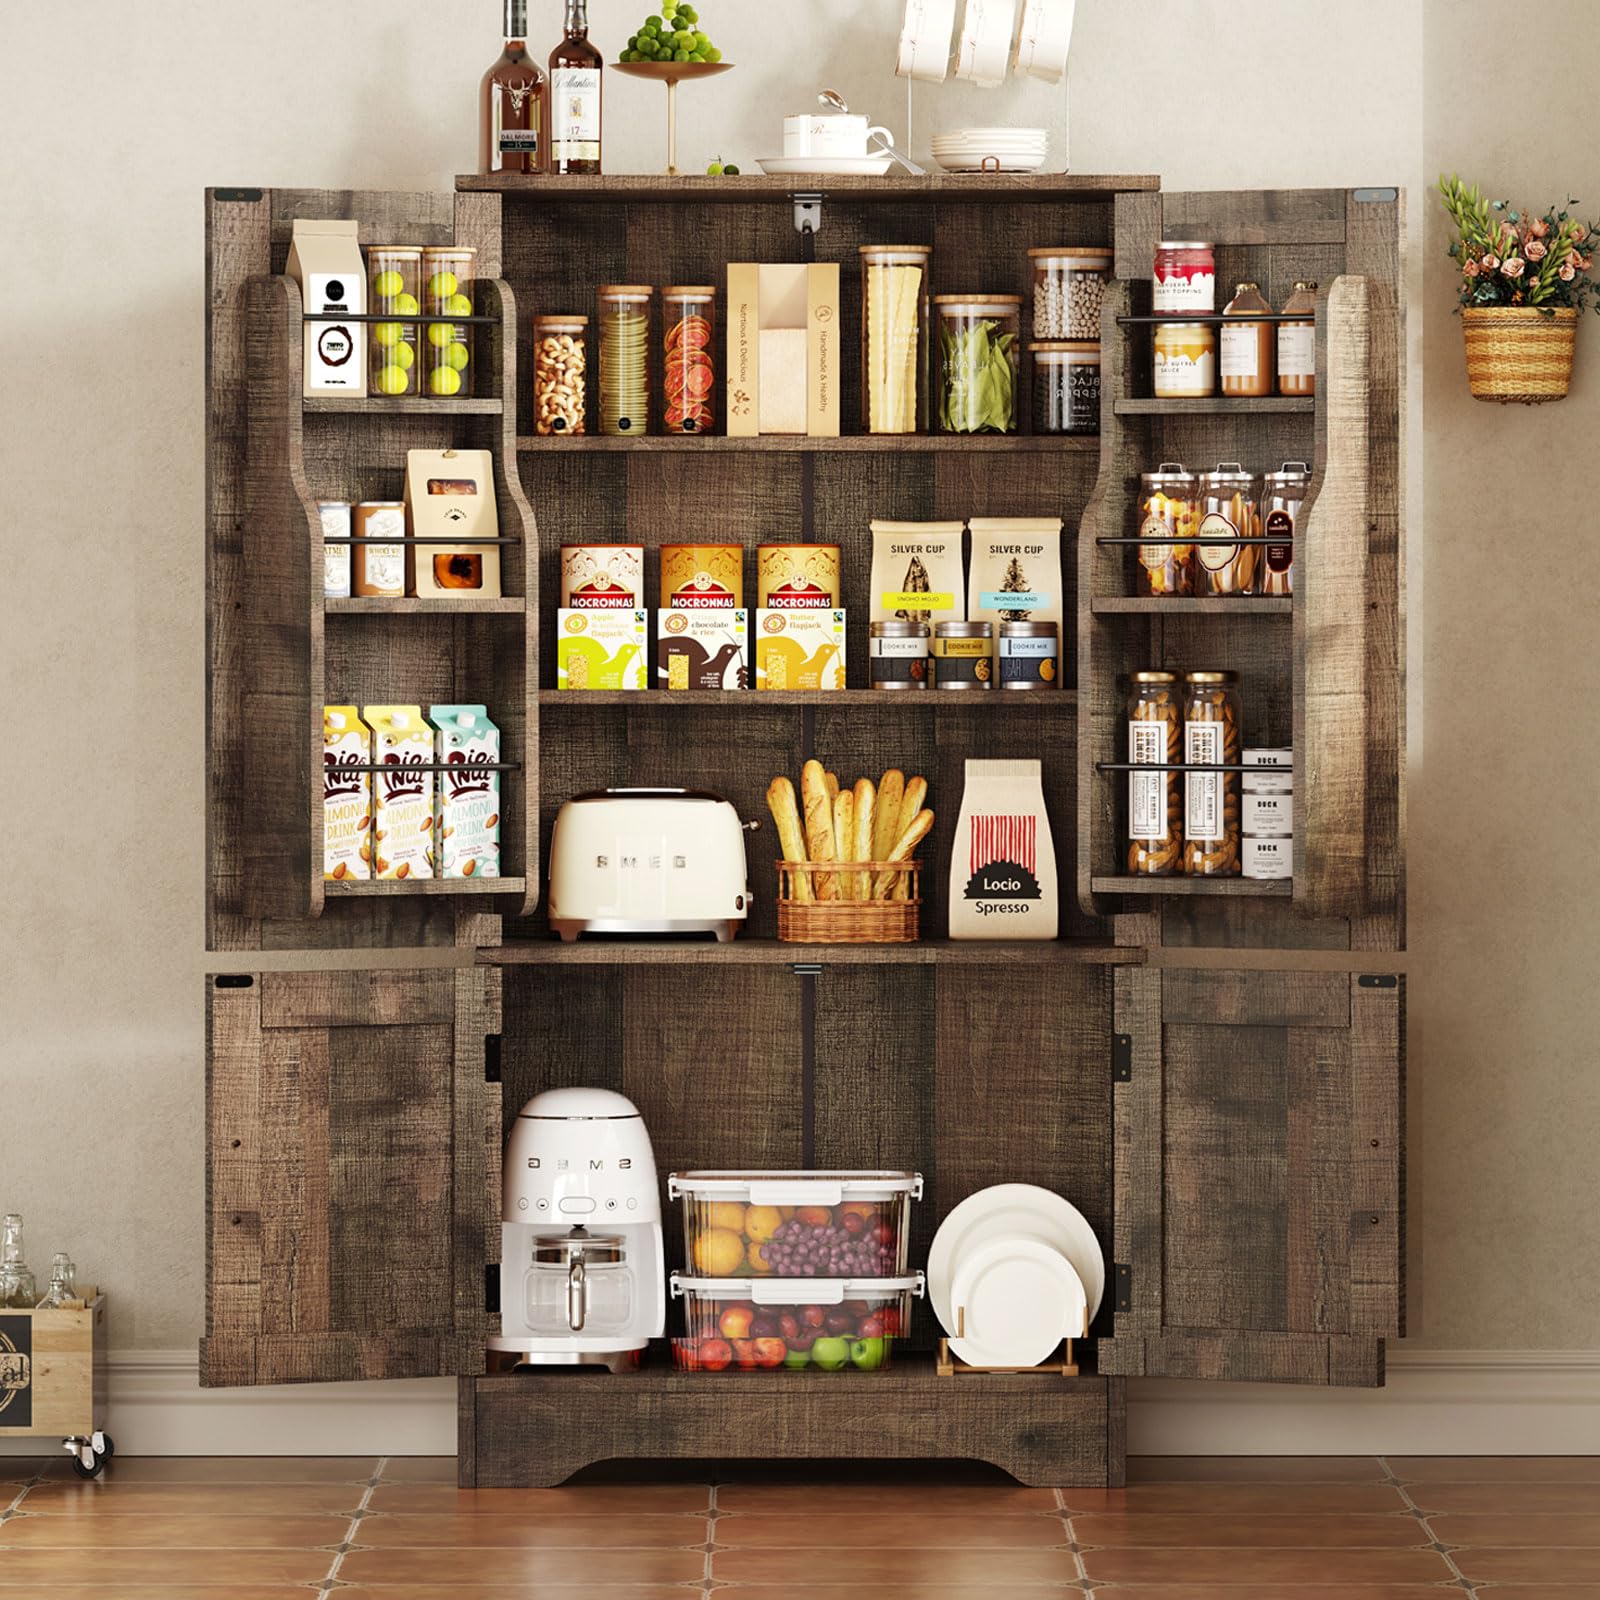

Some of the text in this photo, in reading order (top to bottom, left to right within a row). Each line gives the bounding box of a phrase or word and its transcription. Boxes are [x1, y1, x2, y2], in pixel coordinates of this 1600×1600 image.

[740, 303, 748, 338] Nutritious
[819, 330, 828, 373] Handmade
[740, 348, 748, 383] Delicious
[819, 383, 828, 412] Healthy
[890, 545, 945, 553] SILVER CUP
[989, 545, 1044, 554] SILVER CUP
[571, 598, 633, 608] MOCRONNAS
[672, 598, 734, 608] MOCRONNAS
[768, 598, 830, 608] MOCRONNAS
[789, 622, 822, 631] flapjack
[327, 823, 356, 840] DRINK
[456, 818, 484, 837] DRINK
[595, 855, 686, 869] SMEG
[983, 877, 1021, 891] Locio
[975, 901, 1029, 916] Spresso
